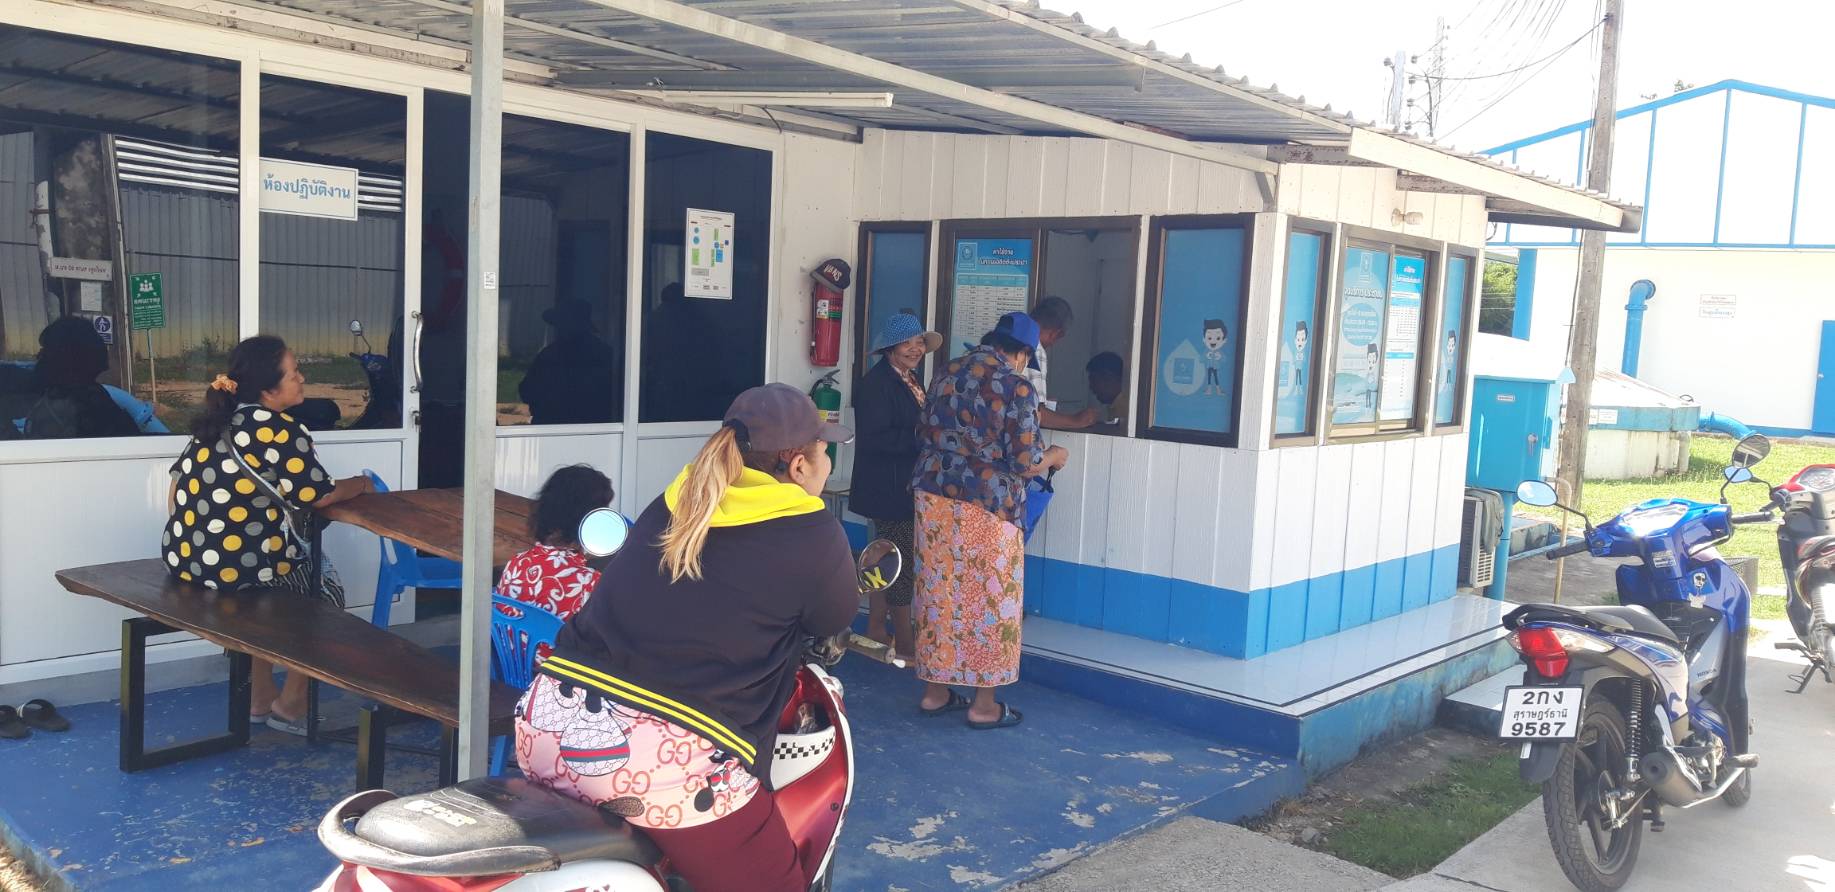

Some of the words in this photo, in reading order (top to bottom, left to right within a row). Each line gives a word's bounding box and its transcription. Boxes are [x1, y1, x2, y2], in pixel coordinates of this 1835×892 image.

[263, 173, 351, 200] ห้องปฏิบัติงาน
[823, 264, 843, 281] VANS
[1522, 691, 1564, 704] 2กง
[1513, 707, 1568, 721] สุราษฎร์ธานี
[1511, 722, 1566, 736] 9587
